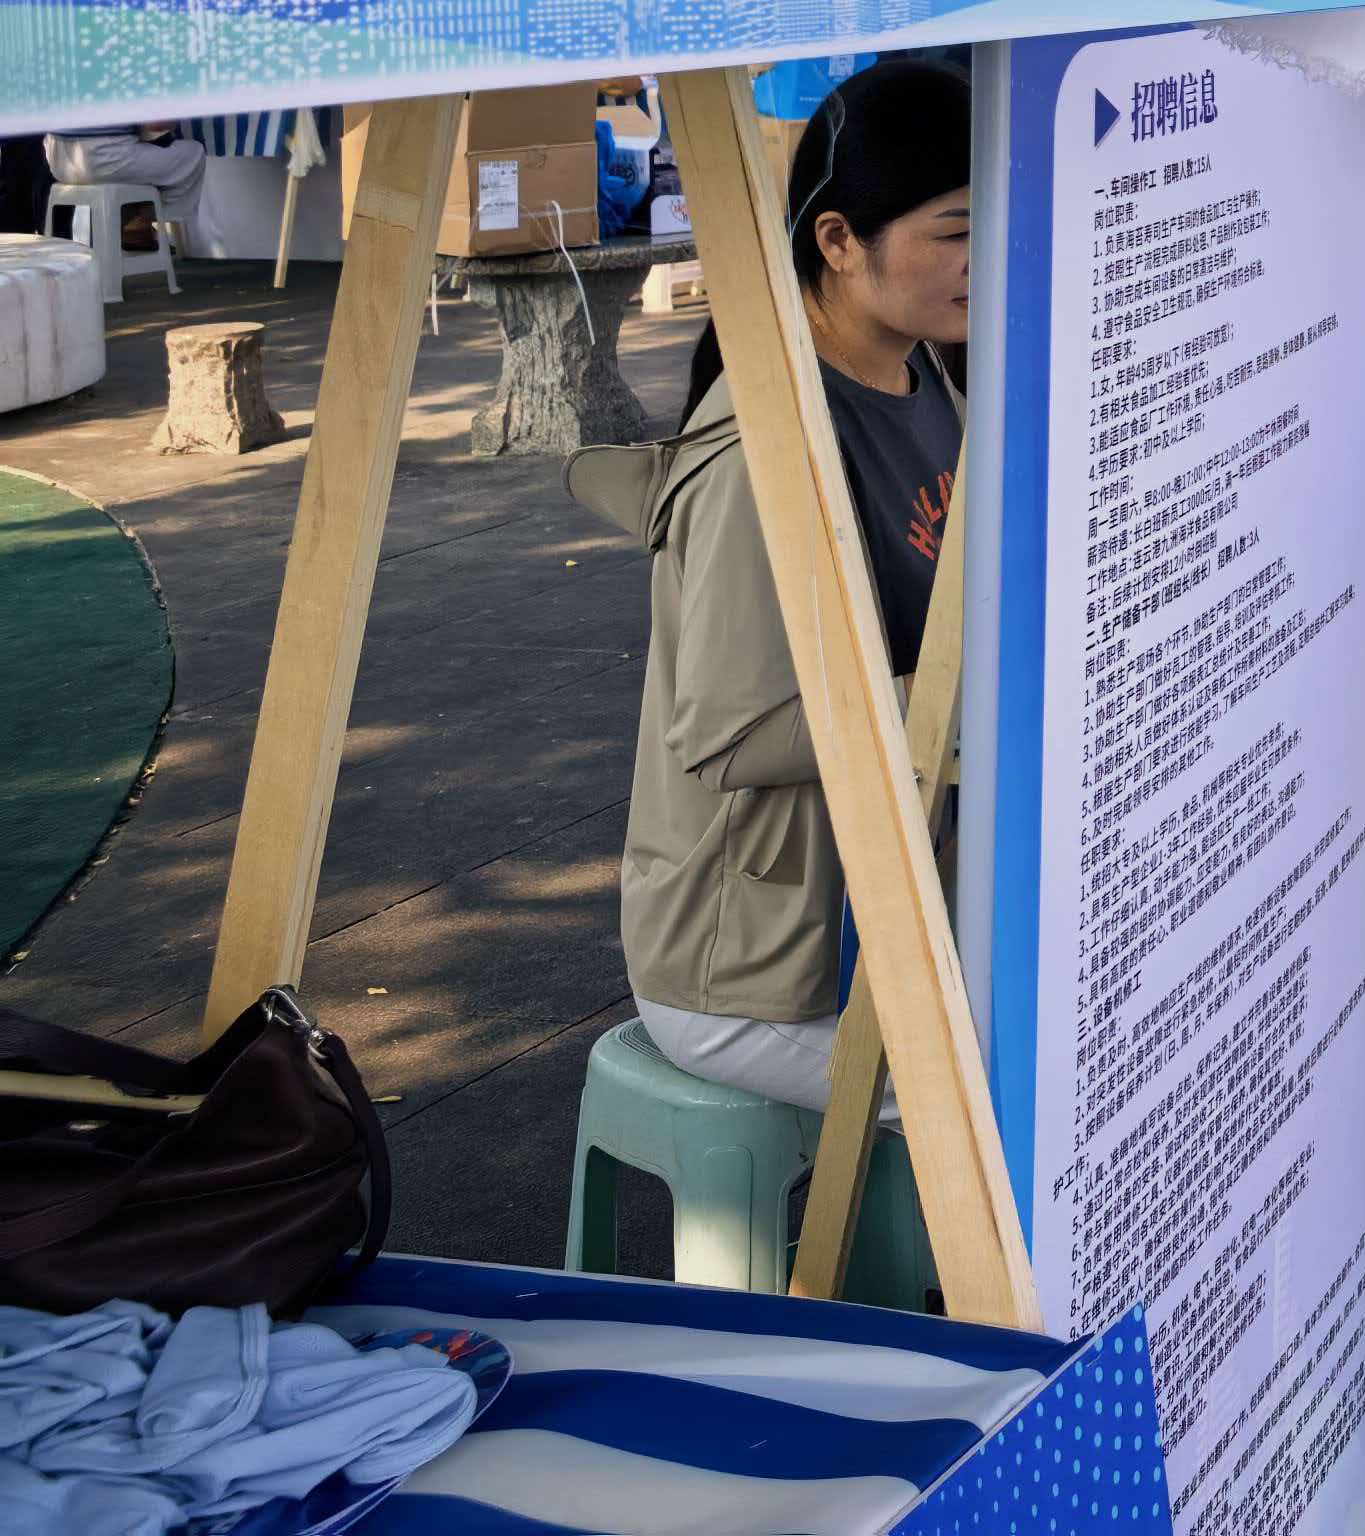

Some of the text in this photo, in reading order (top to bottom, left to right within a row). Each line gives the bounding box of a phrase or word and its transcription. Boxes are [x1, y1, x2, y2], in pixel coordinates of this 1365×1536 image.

[1131, 69, 1218, 143] 招聘信息
[1094, 167, 1156, 205] 一、车间操作工
[1094, 200, 1138, 232] 岗位职责：
[1091, 335, 1136, 373] 任职要求：
[1088, 470, 1134, 513] 工作时间：
[1085, 634, 1130, 683] 岗位职责：
[1080, 823, 1125, 878] 任职要求：
[1077, 966, 1142, 1045] 三、设备机修工
[1076, 1011, 1121, 1072] 岗位职责：
[1053, 1149, 1089, 1204] 护工作；
